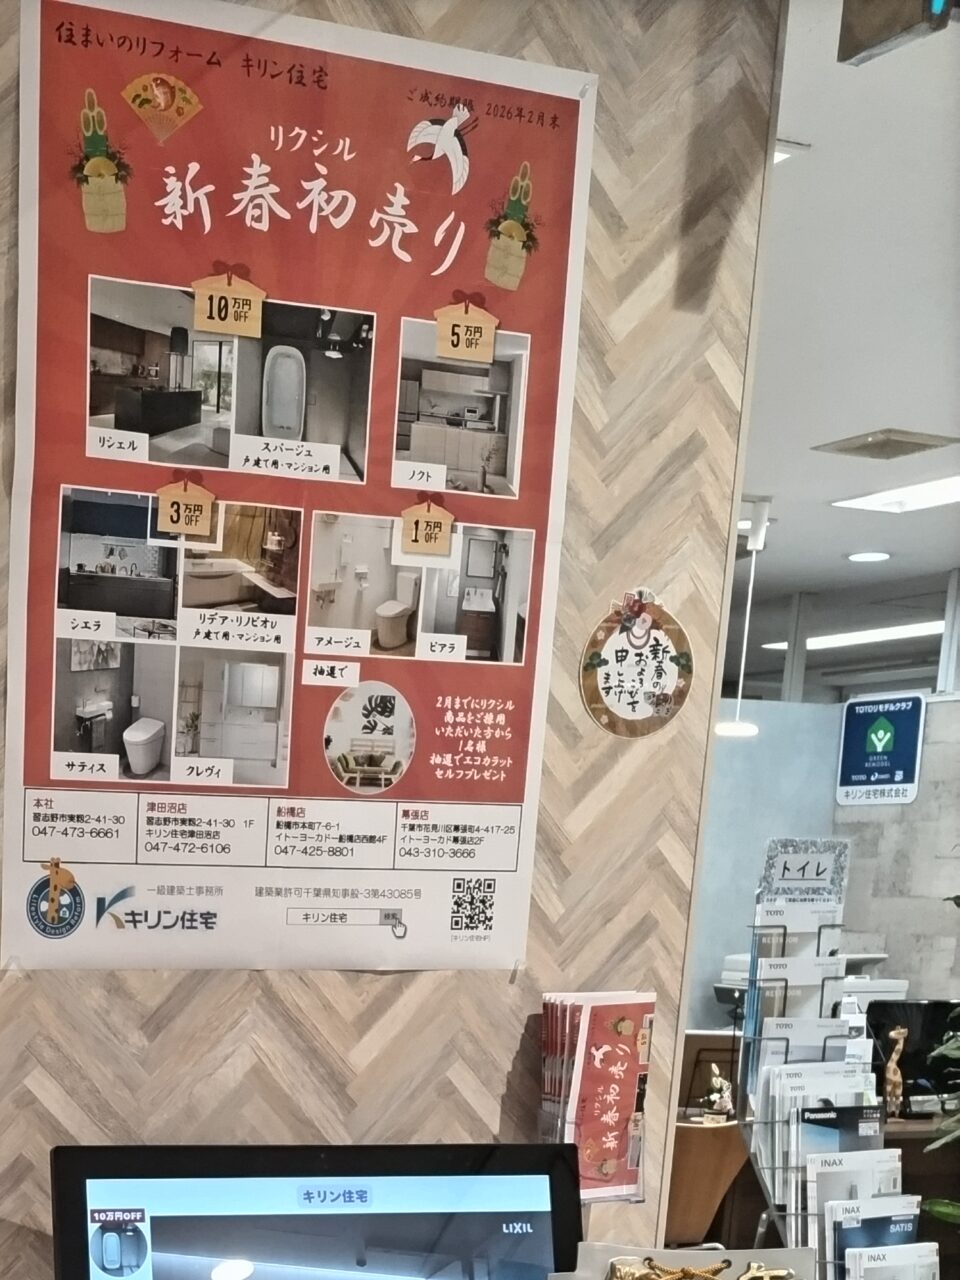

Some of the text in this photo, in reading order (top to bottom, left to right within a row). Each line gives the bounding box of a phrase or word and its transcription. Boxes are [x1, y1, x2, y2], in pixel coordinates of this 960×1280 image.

[54, 20, 330, 92] 住まいのリフォーム キリン住宅
[485, 102, 562, 130] 2026年2月末
[268, 125, 358, 162] リクシル
[153, 151, 467, 278] 新春初売り
[233, 310, 249, 323] OFF
[465, 338, 480, 350] OFF
[98, 436, 138, 452] リシェル
[262, 442, 313, 458] スパージュ
[408, 470, 433, 483] ノクト
[184, 515, 200, 527] OFF
[424, 532, 439, 543] OFF
[70, 618, 102, 631] シエラ
[314, 636, 362, 650] アメージュ
[312, 664, 348, 679] 抽選で
[435, 696, 515, 712] 2月までにリクシル
[435, 726, 512, 740] いただいた方から
[430, 753, 513, 768] 抽選でエコカラット
[65, 761, 107, 774] サティス
[185, 765, 222, 778] クレヴィ
[435, 767, 506, 782] セルフプレゼント
[33, 798, 55, 809] 本社
[146, 802, 188, 815] 津田沼店
[276, 806, 306, 818] 船橋店
[401, 809, 430, 821] 幕張店
[243, 819, 256, 829] 1F
[32, 826, 120, 839] 047-473-6661
[145, 828, 221, 840] キリン住宅津田沼店
[144, 841, 232, 855] 047-472-6106
[274, 846, 355, 858] 047-425-8801
[399, 847, 477, 860] 043-310-3666
[781, 860, 828, 879] トイレ
[124, 909, 218, 930] キリン住宅
[302, 912, 348, 924] キリン住宅
[804, 1111, 838, 1120] Panasonic
[820, 1158, 844, 1168] INAX
[302, 1188, 369, 1205] キリン住宅
[92, 1211, 143, 1223] 10万円OFF
[841, 1206, 861, 1215] INAX
[502, 1222, 534, 1234] LIXIL
[889, 1222, 914, 1233] SATIS
[867, 1253, 888, 1263] INAX
